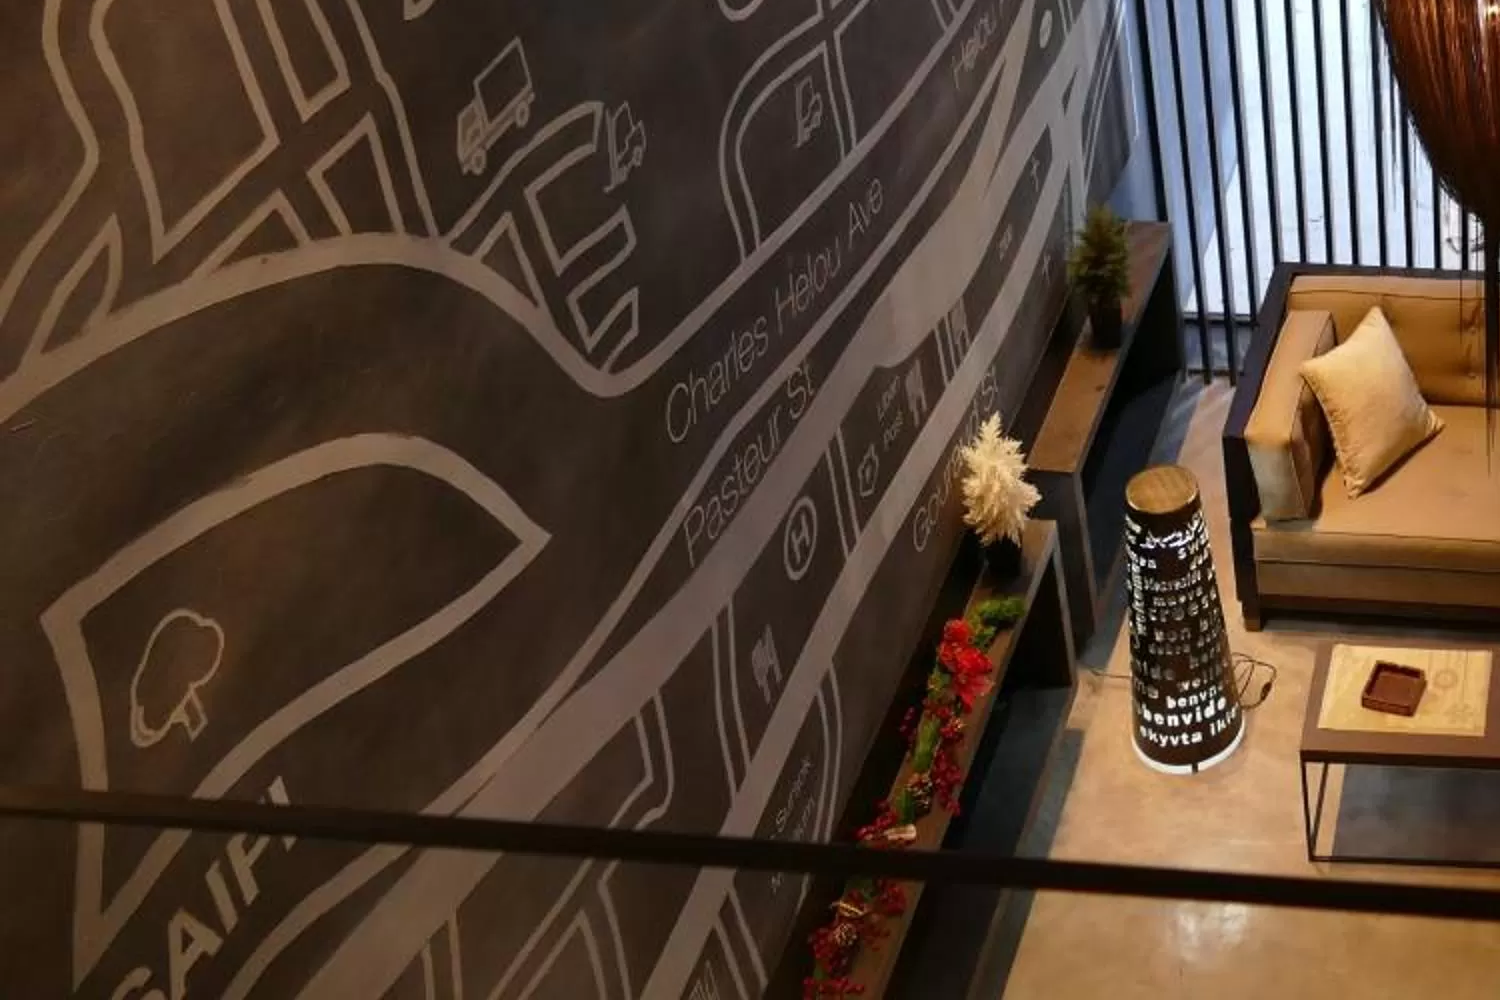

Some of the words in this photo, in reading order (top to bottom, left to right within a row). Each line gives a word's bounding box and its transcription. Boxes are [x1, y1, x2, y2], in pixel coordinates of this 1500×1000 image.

[666, 315, 769, 443] Charles
[775, 239, 841, 336] Helou
[848, 177, 884, 251] Ave
[683, 404, 781, 568] Pasteur
[786, 361, 815, 418] St
